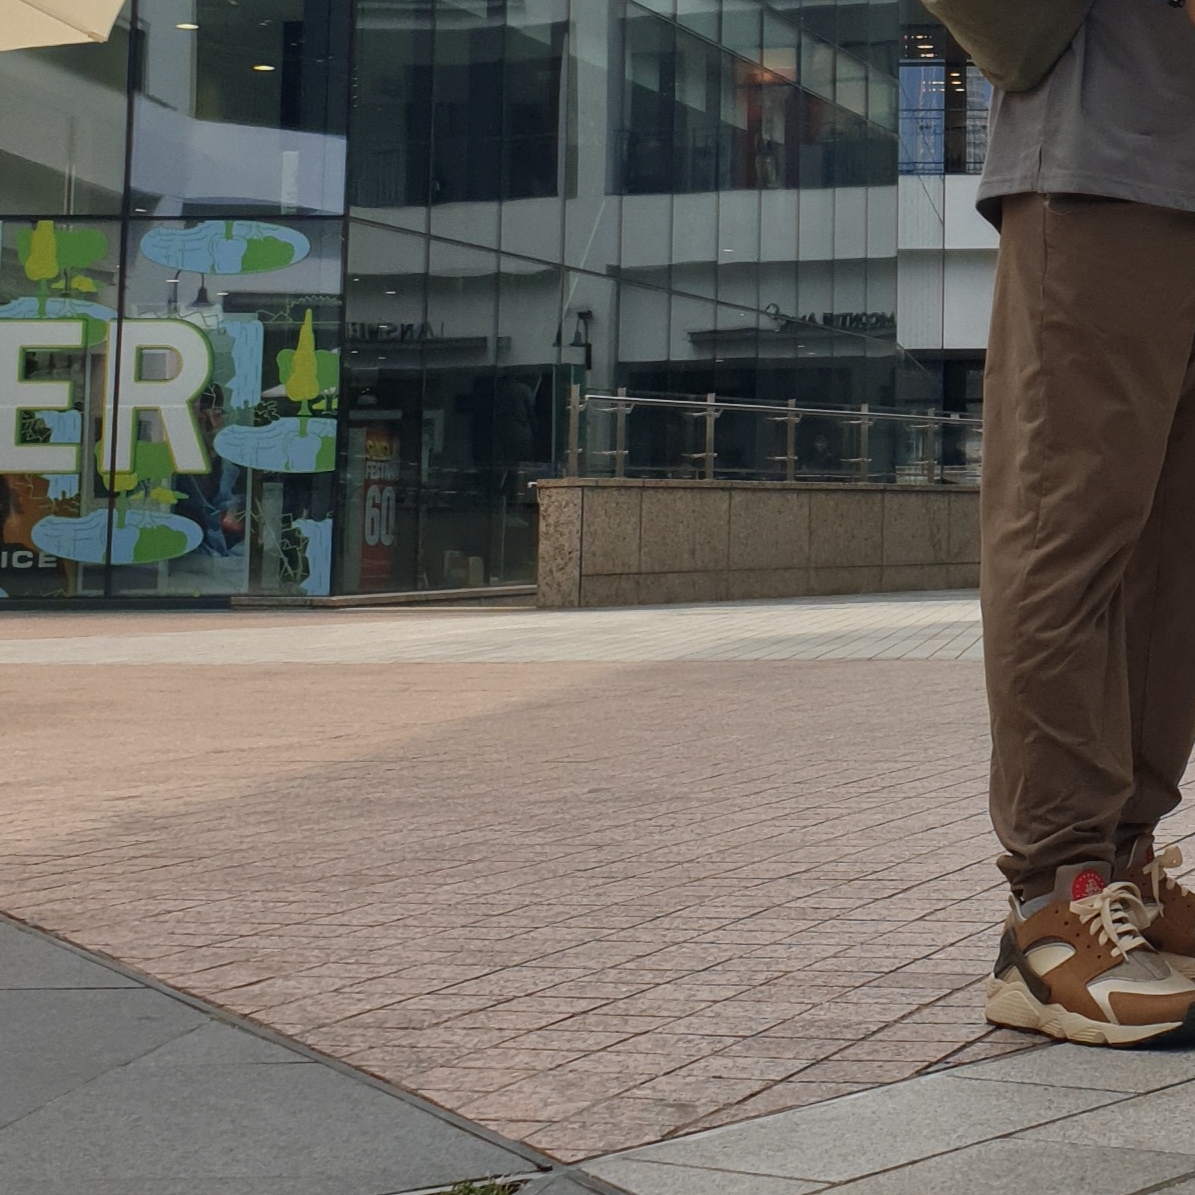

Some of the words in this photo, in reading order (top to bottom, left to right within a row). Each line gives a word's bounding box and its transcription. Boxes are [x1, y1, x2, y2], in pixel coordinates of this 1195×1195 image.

[0, 317, 213, 475] ER
[364, 484, 397, 547] 60
[0, 550, 58, 569] ICE
